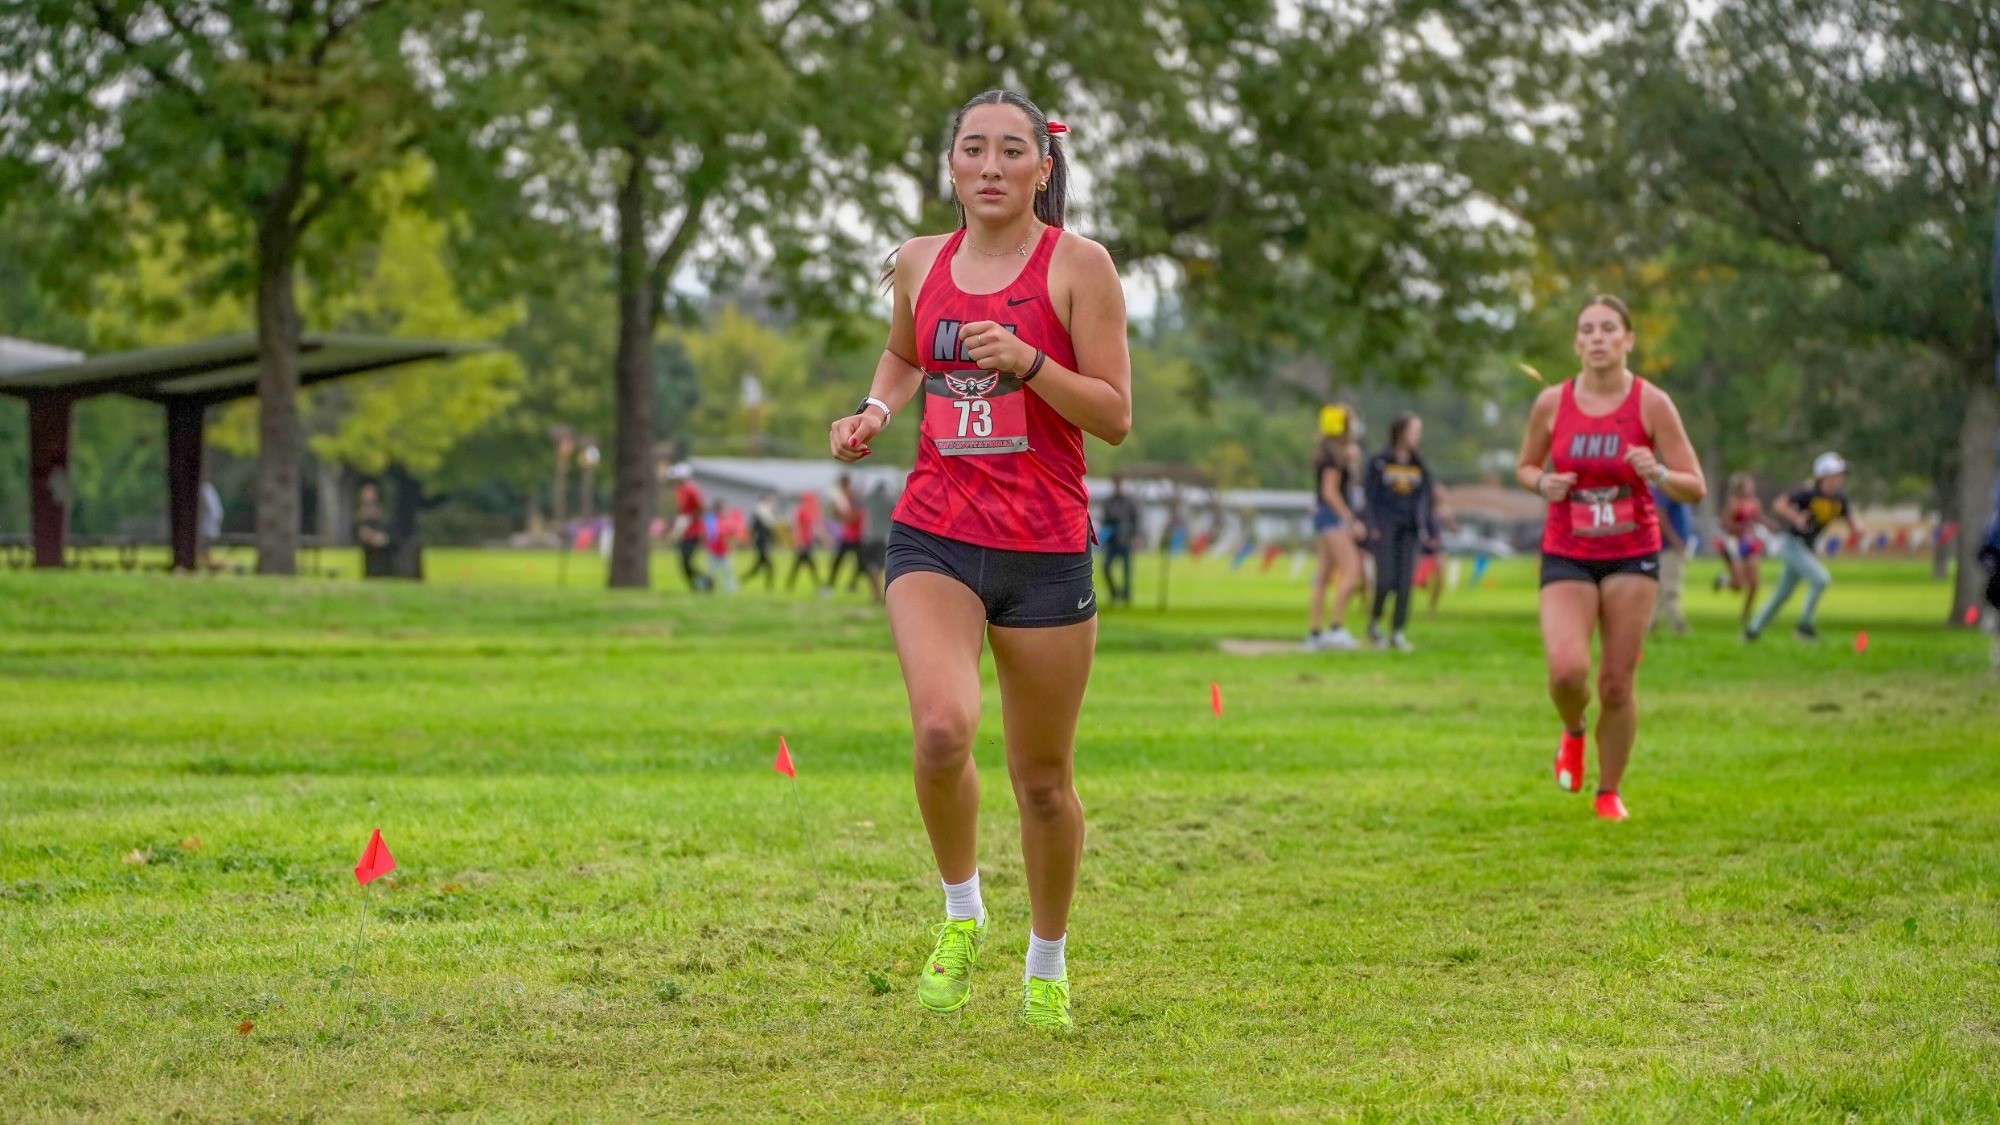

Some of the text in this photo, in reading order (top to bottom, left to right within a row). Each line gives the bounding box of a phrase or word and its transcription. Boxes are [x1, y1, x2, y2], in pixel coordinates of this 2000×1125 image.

[953, 400, 993, 438] 73
[955, 440, 1014, 449] INVITATIONAL
[1569, 433, 1620, 459] NNU
[1589, 503, 1616, 528] 74
